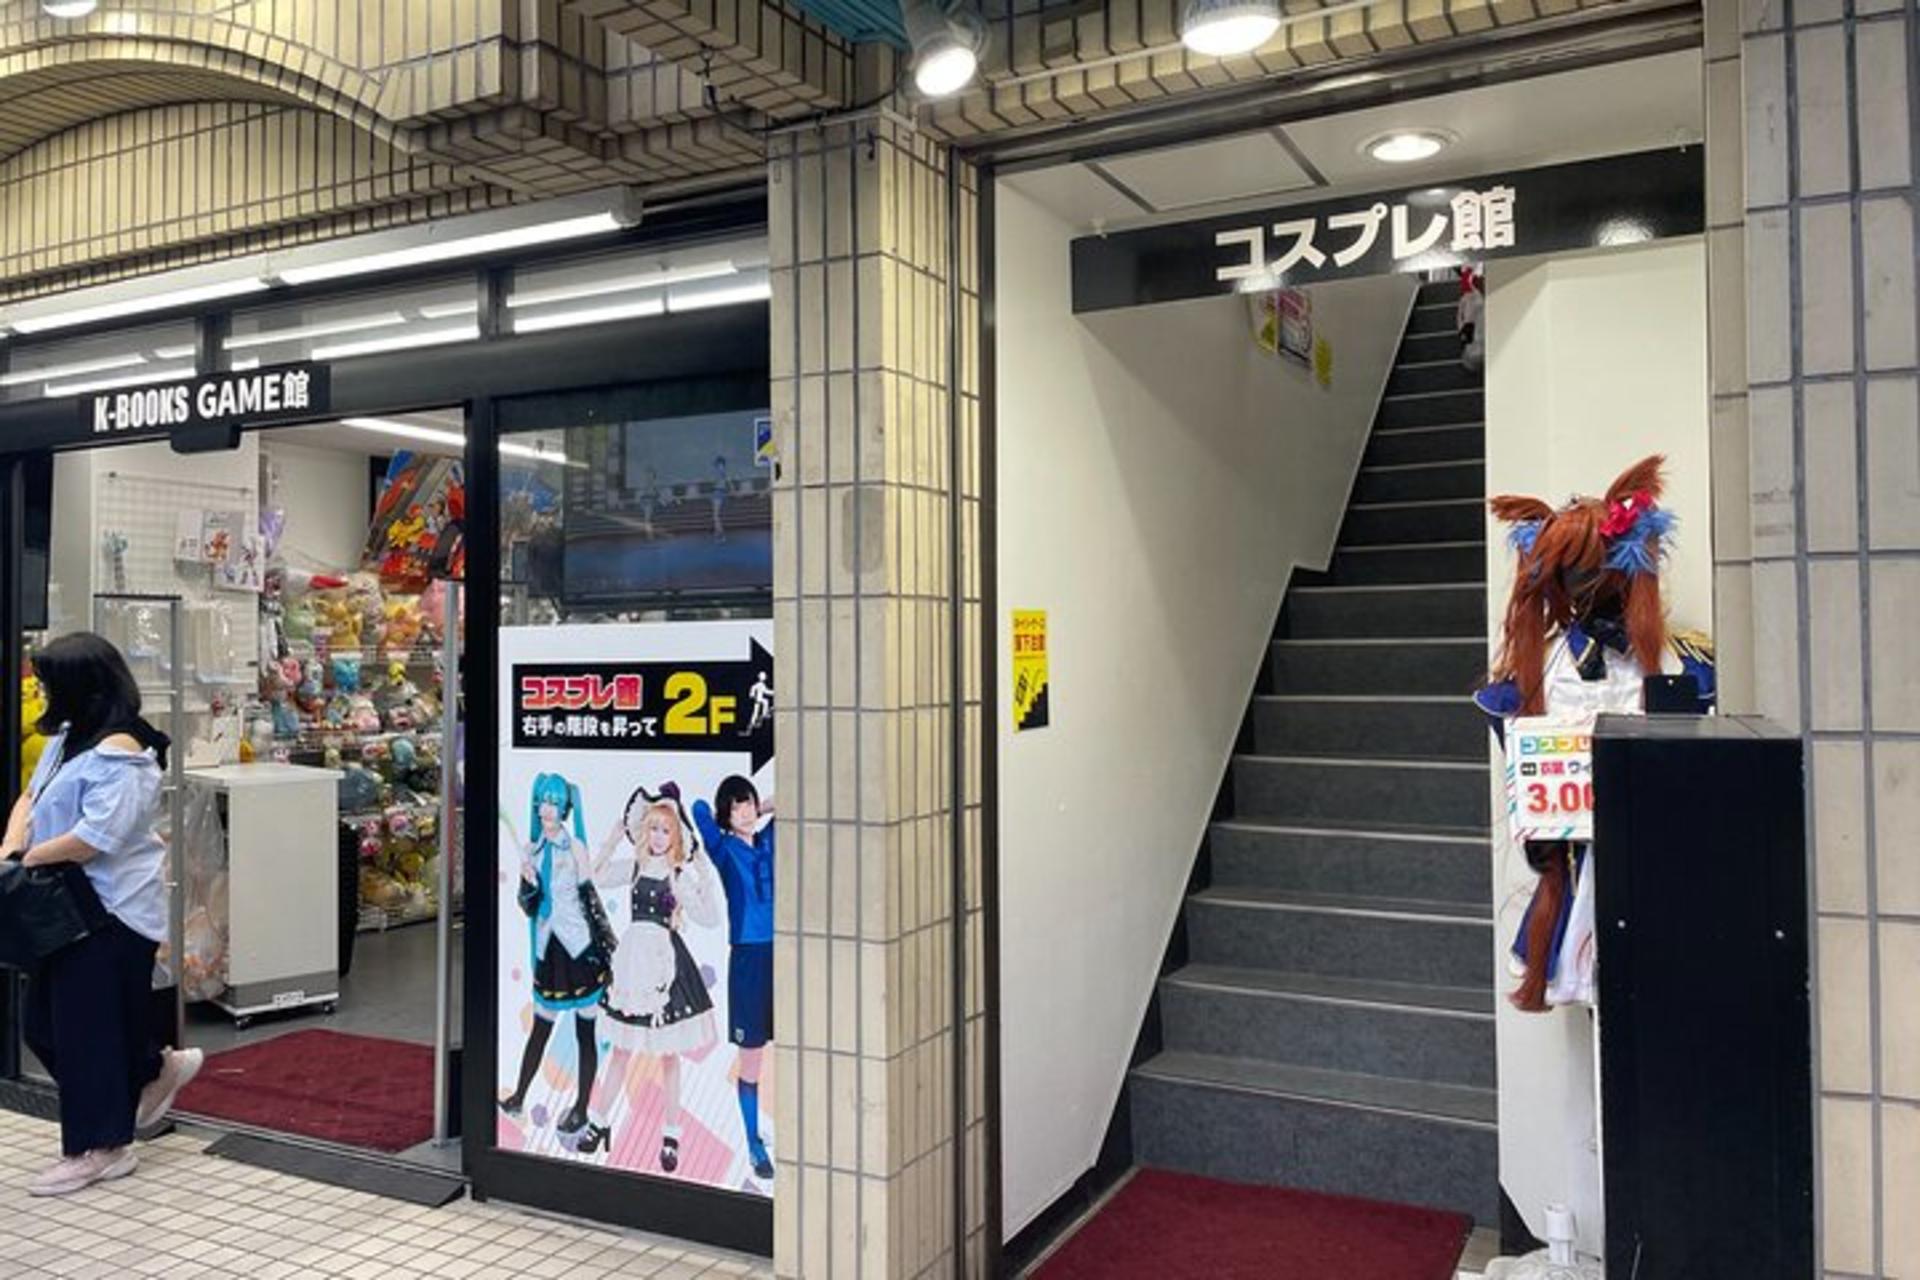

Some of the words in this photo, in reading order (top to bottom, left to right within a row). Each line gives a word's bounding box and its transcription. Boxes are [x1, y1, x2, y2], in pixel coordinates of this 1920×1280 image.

[1215, 186, 1515, 281] コスプレ館
[94, 385, 190, 432] K-BOOKS
[197, 370, 310, 418] GAME館
[521, 674, 644, 710] コスプレ館
[663, 671, 737, 735] 2F
[522, 715, 658, 737] 右手の階段を昇って
